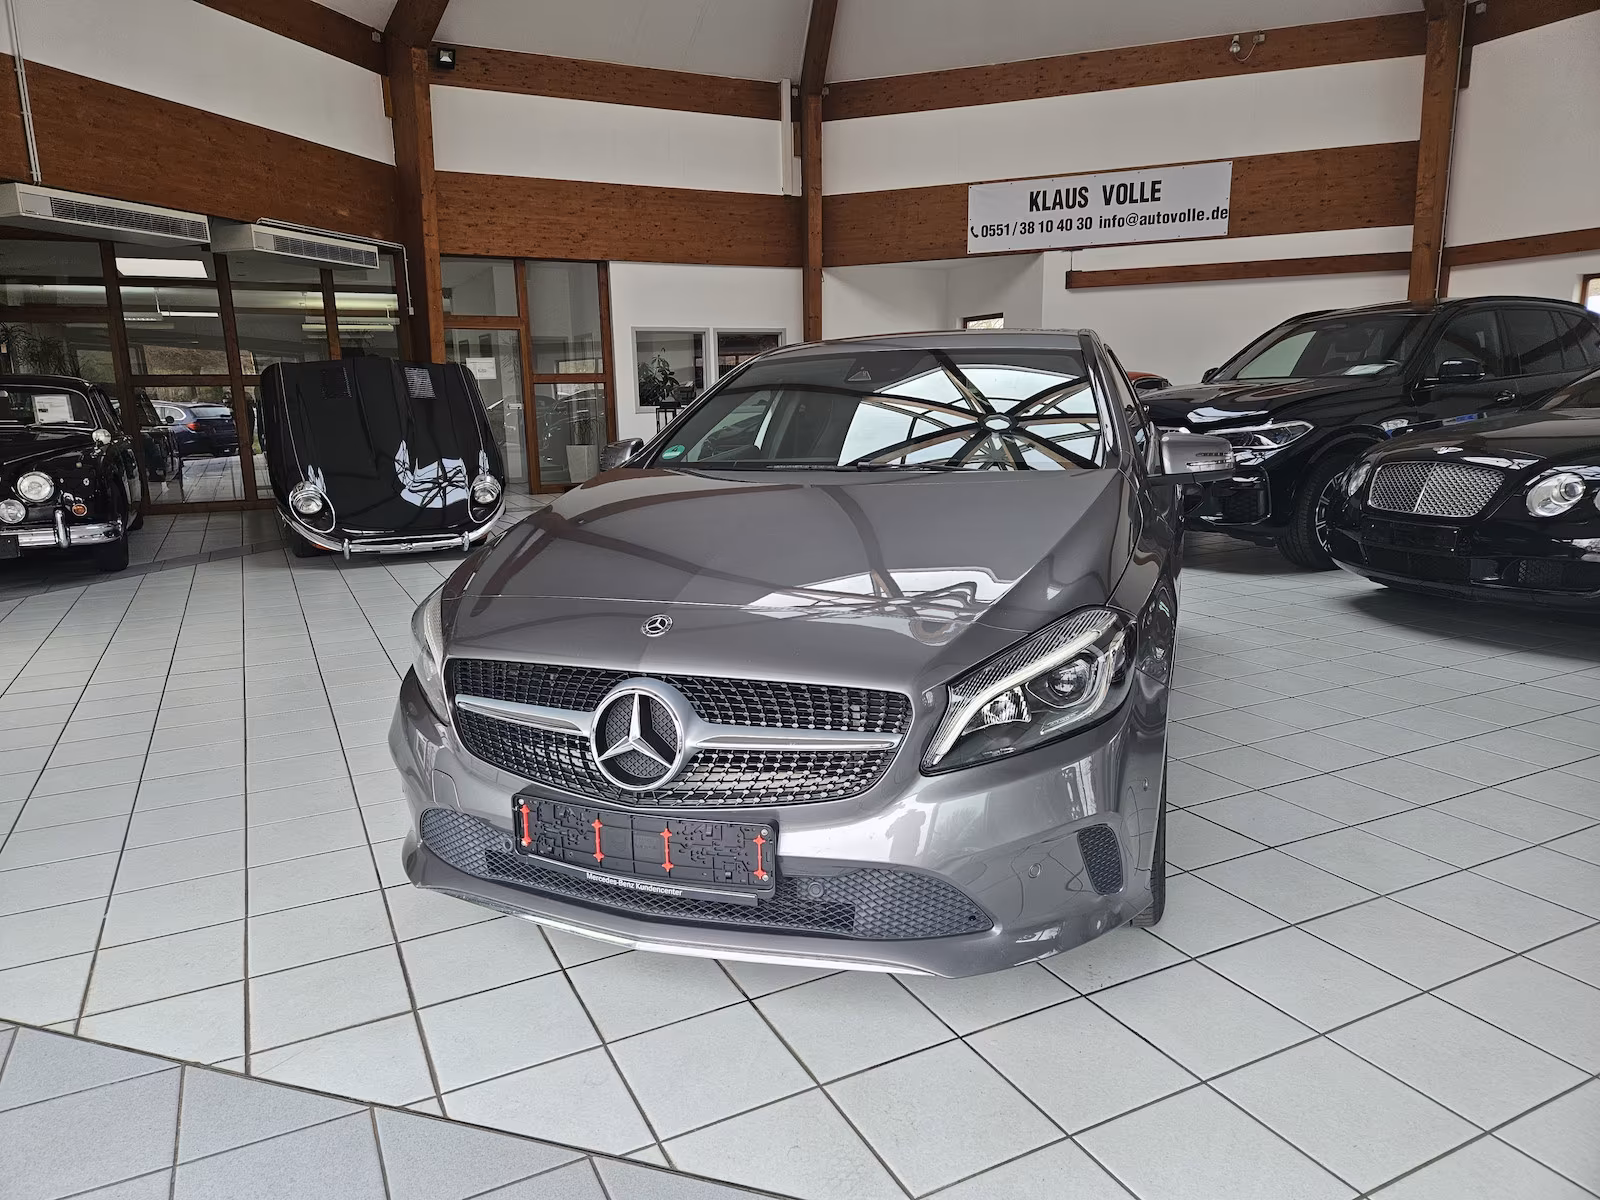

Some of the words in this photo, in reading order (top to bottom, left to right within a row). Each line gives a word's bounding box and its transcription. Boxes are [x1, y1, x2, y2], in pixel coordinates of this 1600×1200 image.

[1029, 186, 1089, 212] KLAUS
[1102, 180, 1162, 206] VOLLE
[1038, 220, 1053, 233] 10
[1056, 218, 1073, 232] 40
[1076, 216, 1093, 230] 30
[1099, 206, 1228, 229] info@autovolle.de
[586, 872, 634, 889] Mercedes-Benz
[635, 883, 682, 896] Kundencenter
